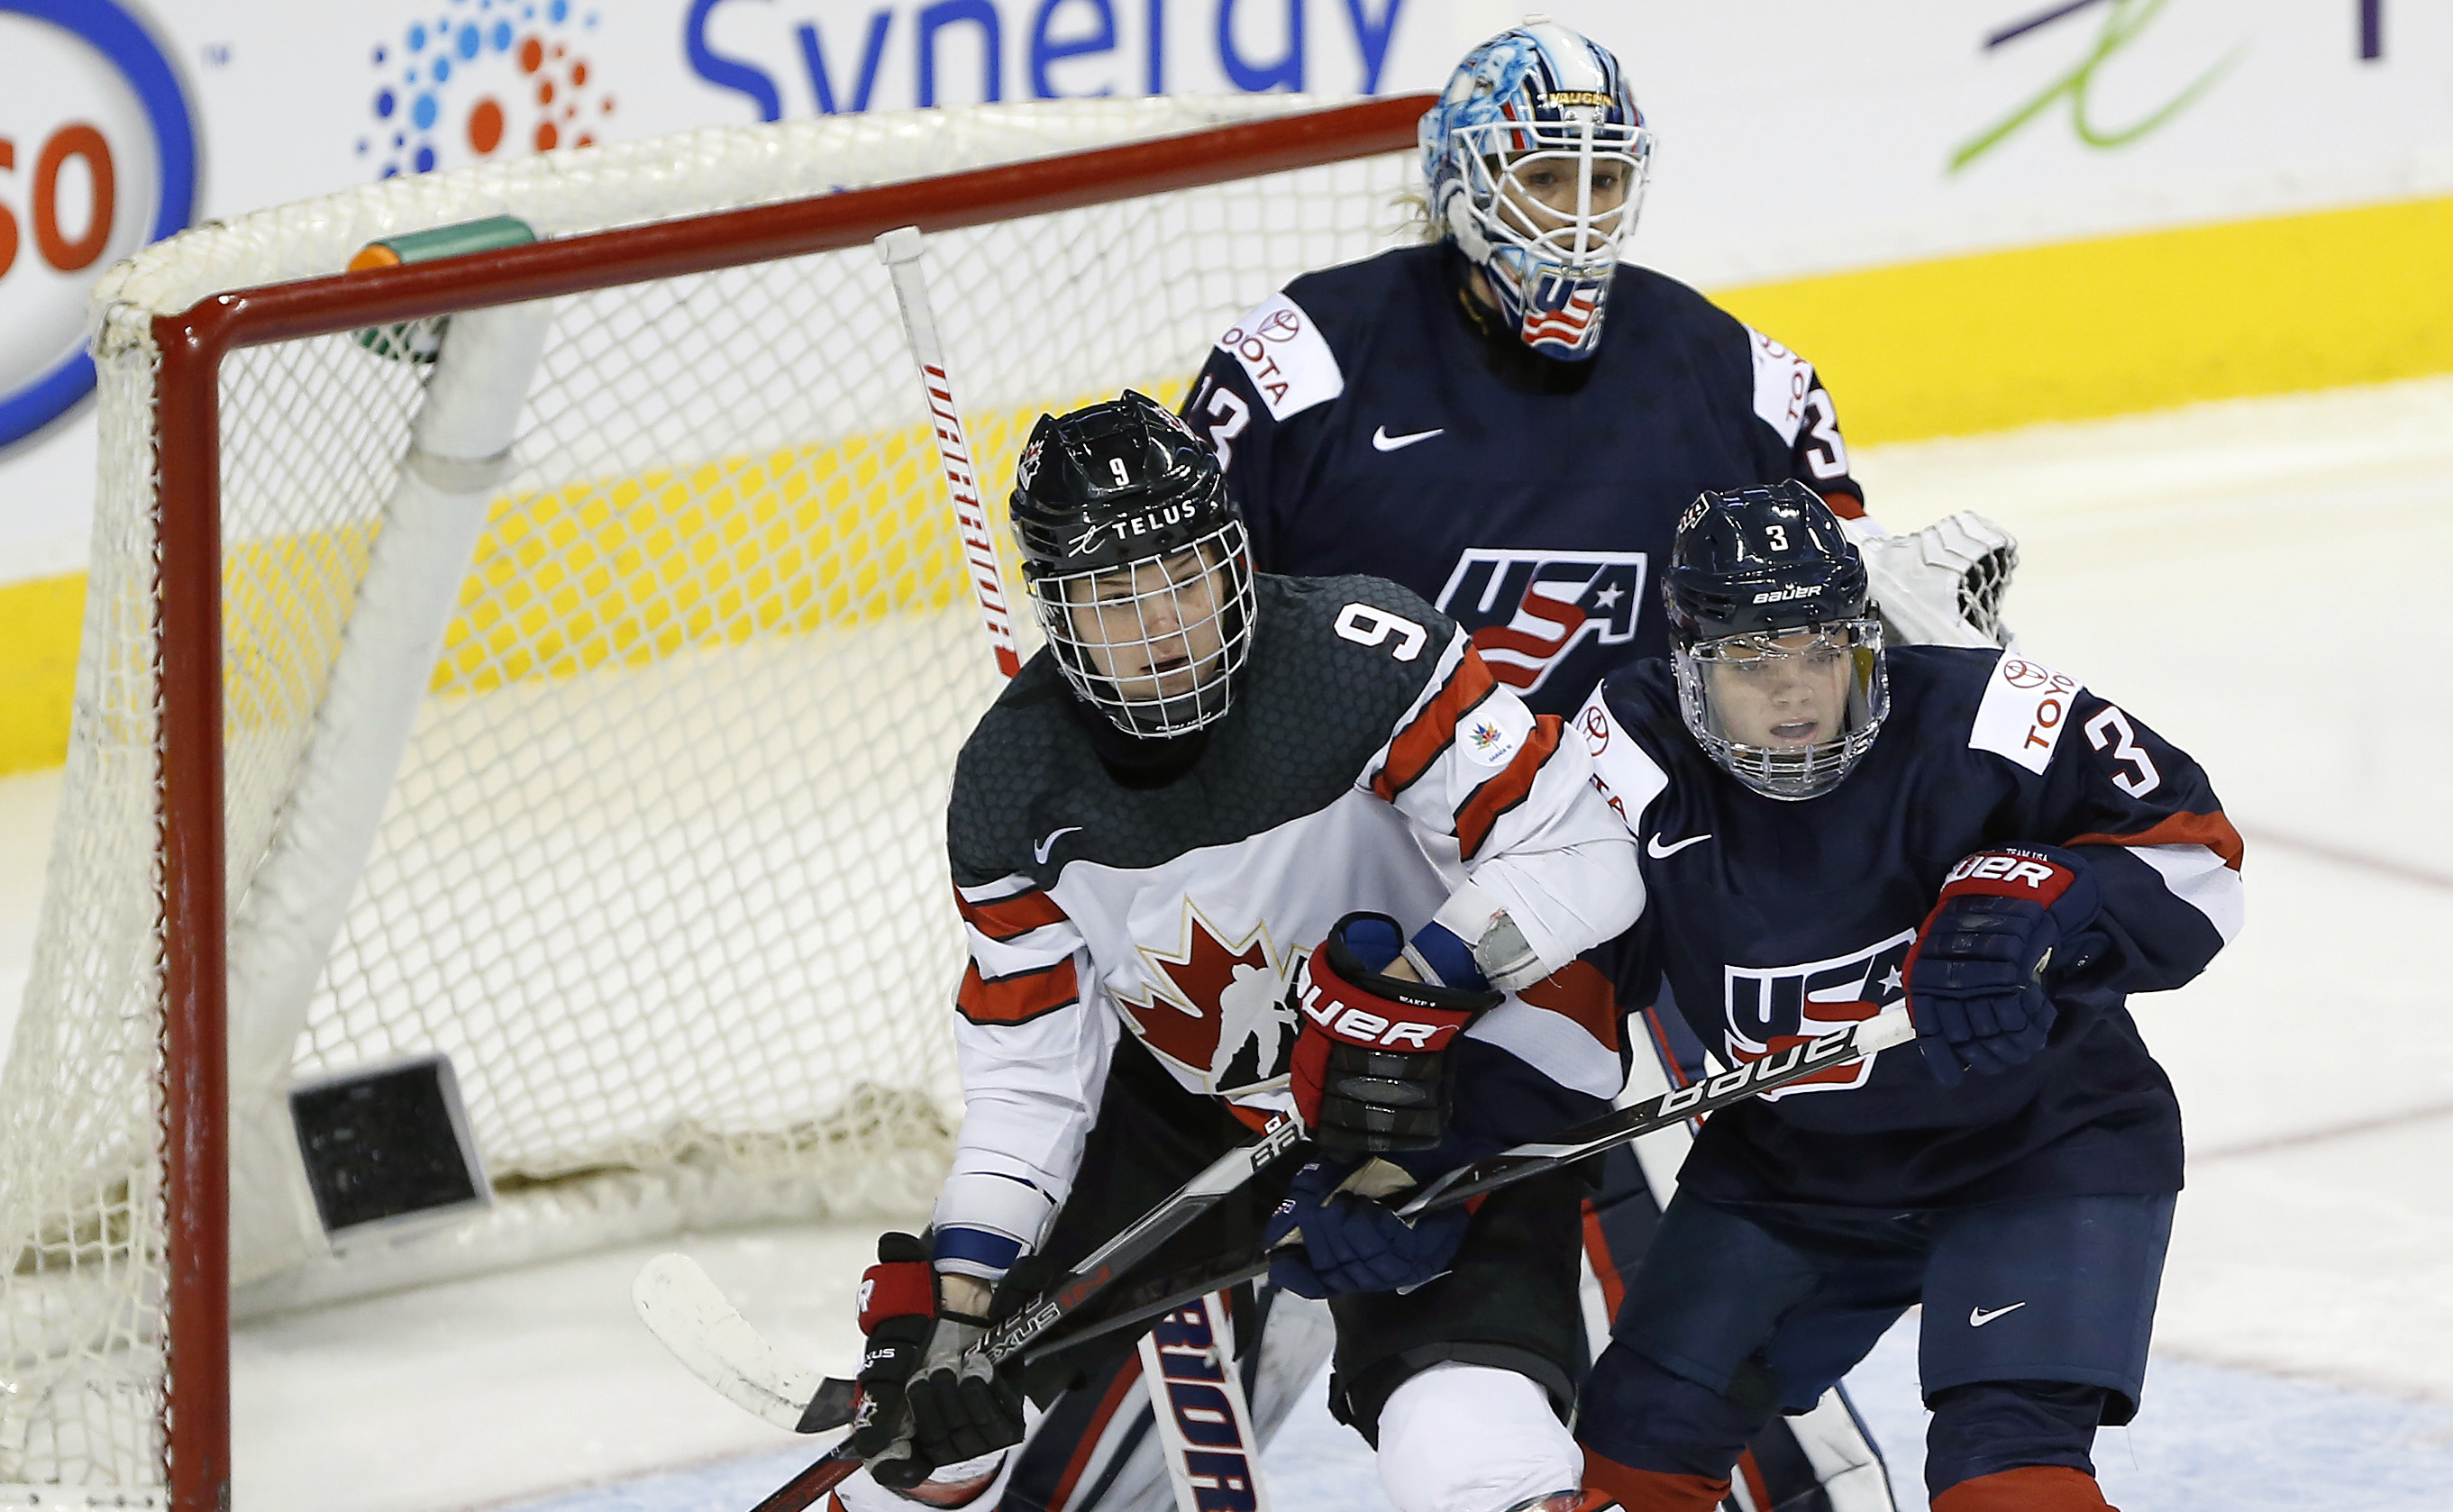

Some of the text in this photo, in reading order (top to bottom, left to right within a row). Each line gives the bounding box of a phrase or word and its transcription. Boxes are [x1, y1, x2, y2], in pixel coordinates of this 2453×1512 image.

[1108, 457, 1130, 487] 9
[1111, 499, 1196, 540] TELUS
[1765, 524, 1790, 552] 3
[1752, 584, 1822, 605] BAUER
[1334, 602, 1429, 662] 9
[1435, 547, 1648, 697] USA
[2083, 703, 2163, 800] 3
[1940, 855, 2055, 890] UER
[1657, 1025, 1858, 1118] BAUE
